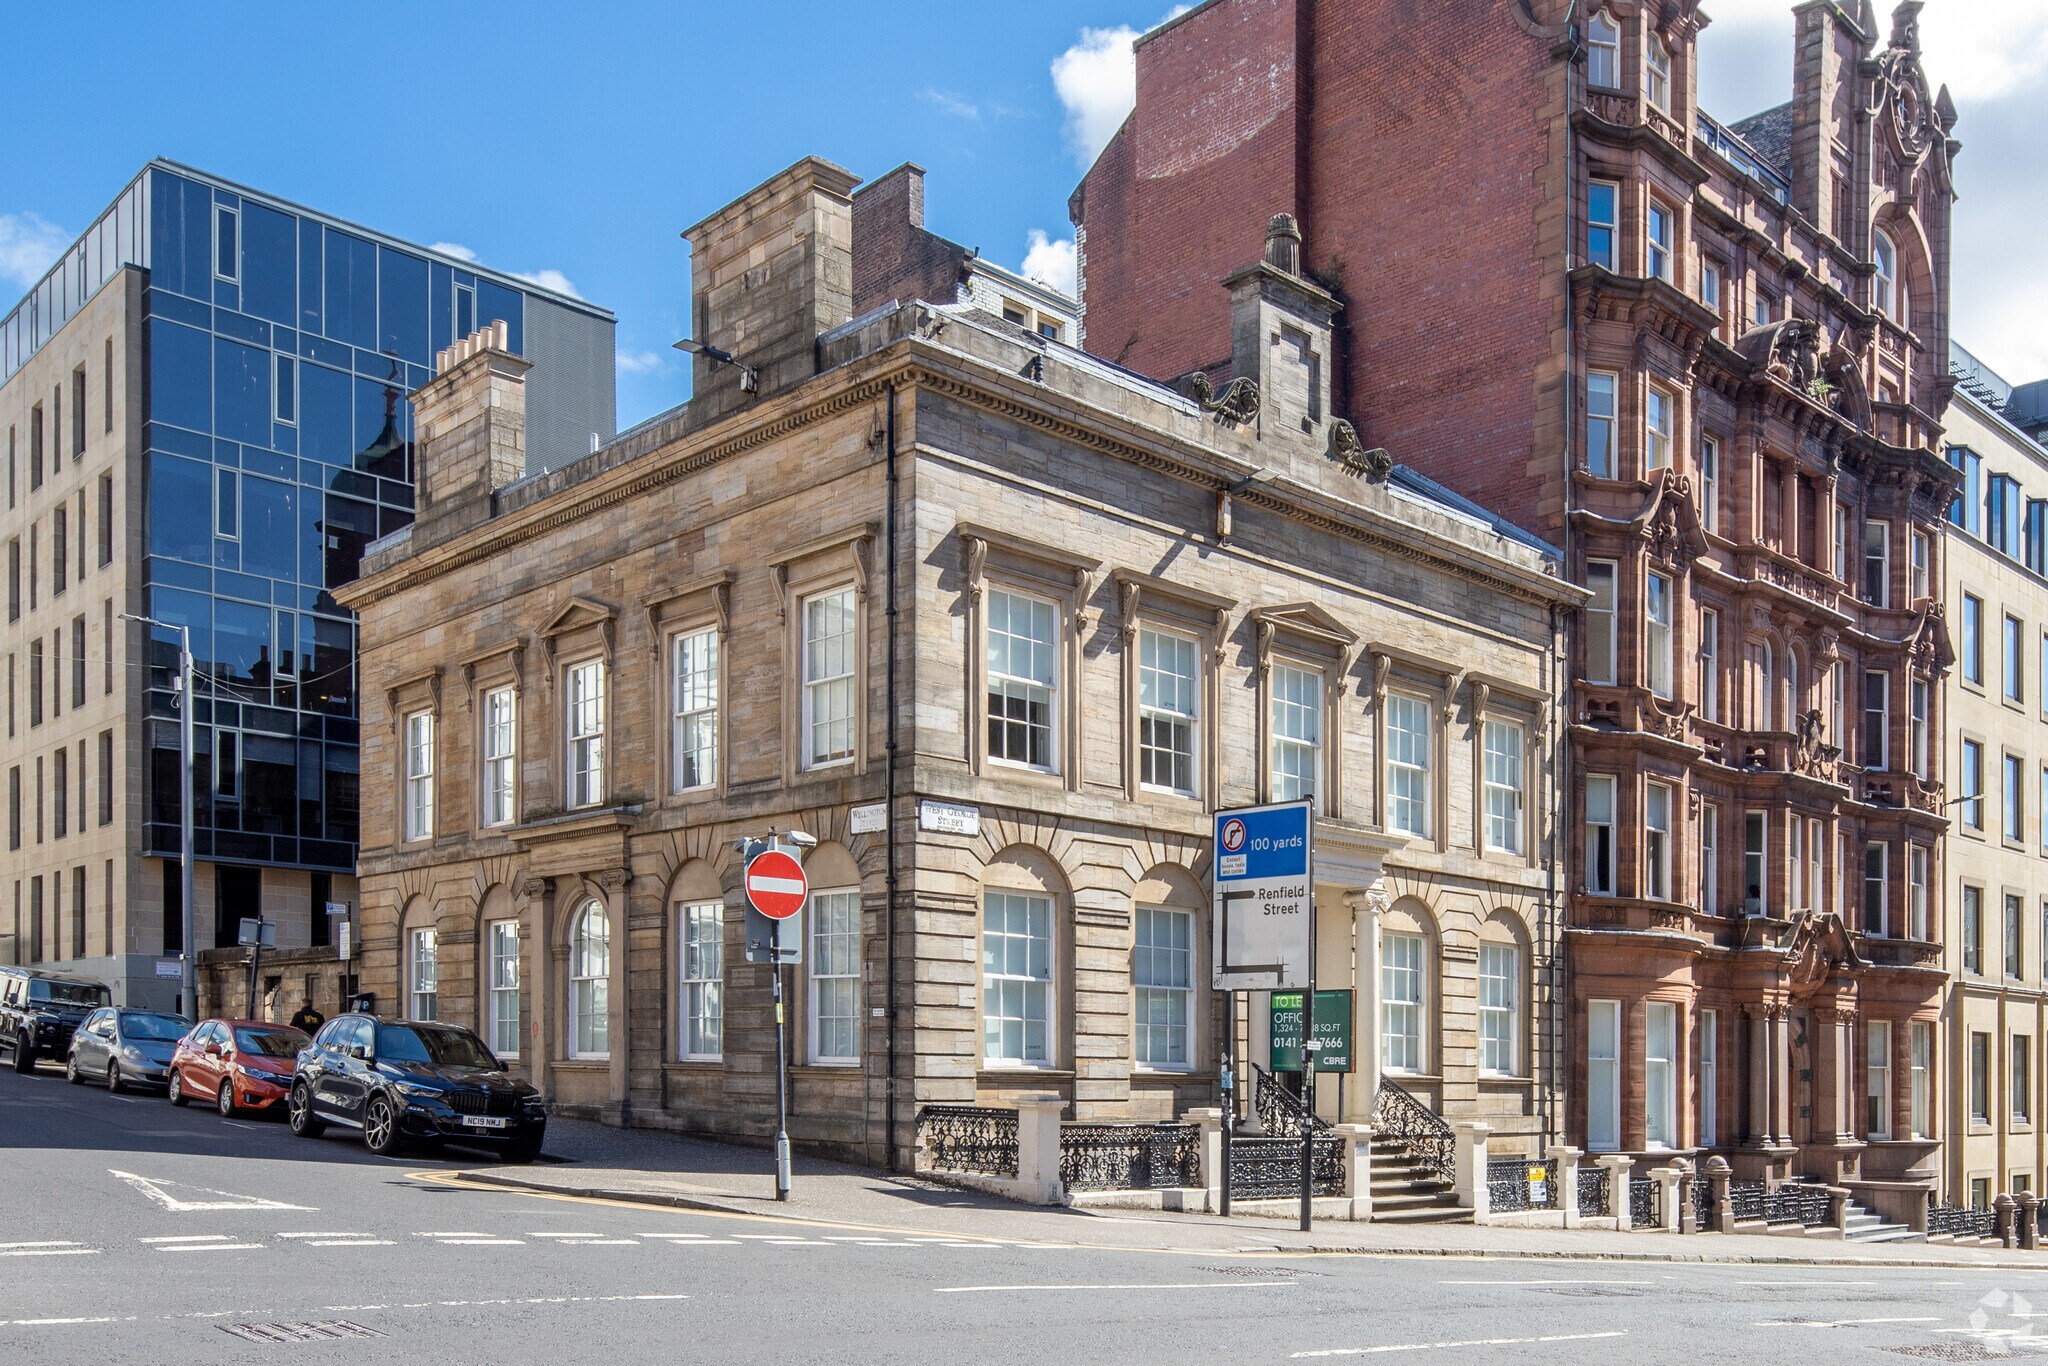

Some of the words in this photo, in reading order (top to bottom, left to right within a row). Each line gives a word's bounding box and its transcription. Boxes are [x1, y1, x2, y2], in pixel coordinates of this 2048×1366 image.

[947, 806, 976, 820] GEORGE
[937, 815, 963, 827] STREET
[1250, 837, 1270, 851] 100
[1273, 835, 1302, 852] yards
[1258, 885, 1304, 900] Renfield
[1263, 902, 1299, 915] Street
[1274, 996, 1288, 1007] TO
[1292, 995, 1303, 1007] LE
[1274, 1012, 1303, 1023] OFFIC
[1274, 1024, 1293, 1033] 1,324
[1320, 1023, 1341, 1032] SQ.FT
[1274, 1037, 1296, 1048] 0141
[1320, 1037, 1343, 1048] 7666
[1323, 1056, 1347, 1065] CBRE
[467, 1117, 485, 1125] NC19
